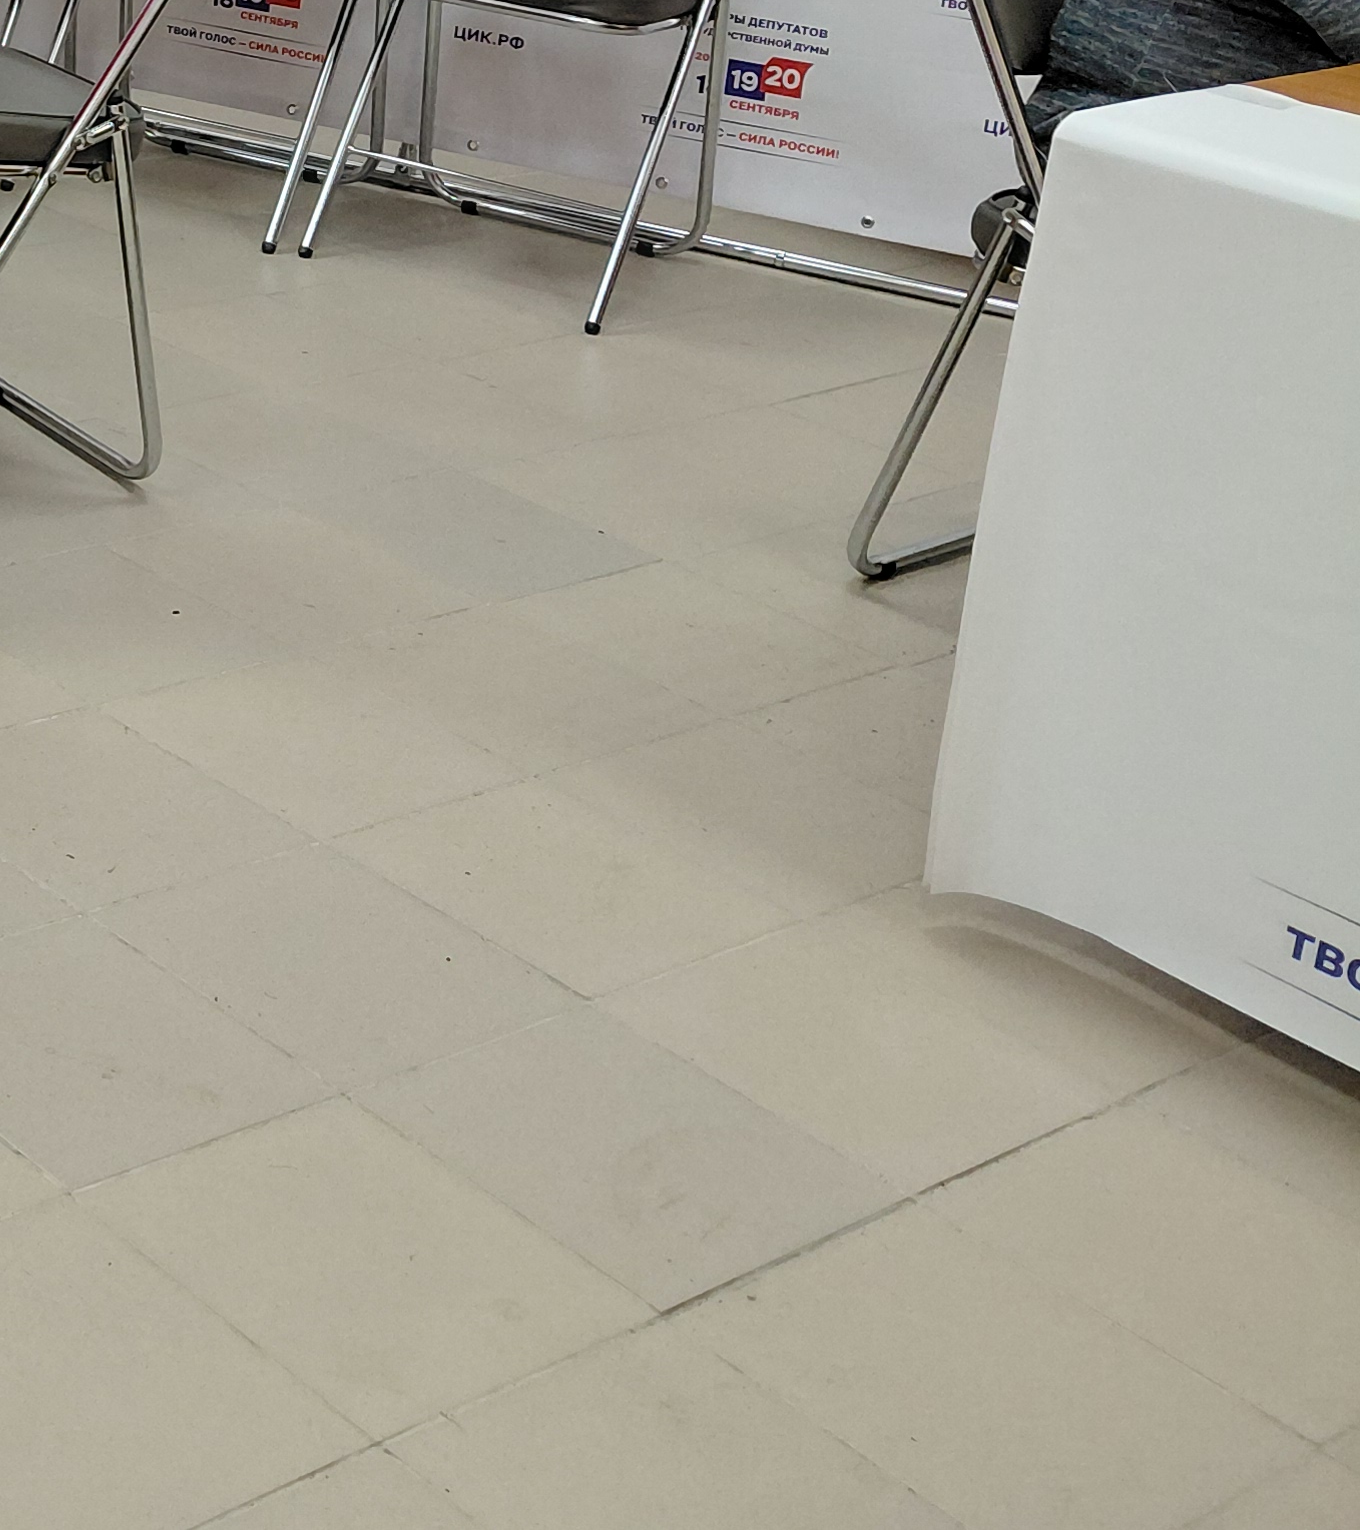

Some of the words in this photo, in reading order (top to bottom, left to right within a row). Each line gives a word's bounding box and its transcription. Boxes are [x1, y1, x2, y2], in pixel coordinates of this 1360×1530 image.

[240, 11, 299, 29] СЕНТЯБРЯ
[748, 16, 829, 39] ДЕПУТАТОВ
[167, 24, 197, 38] ТВОЙ
[199, 32, 237, 46] ГОЛОС
[248, 41, 279, 54] СИЛА
[282, 47, 327, 63] РОССИ
[454, 26, 524, 49] ЦИК.РФ
[793, 43, 830, 56] ДУМЫ
[732, 70, 758, 91] 19
[762, 61, 803, 90] 20
[729, 100, 799, 121] СЕНТЯБРЯ
[738, 132, 775, 147] СИЛА
[779, 139, 840, 159] РОССИИ!
